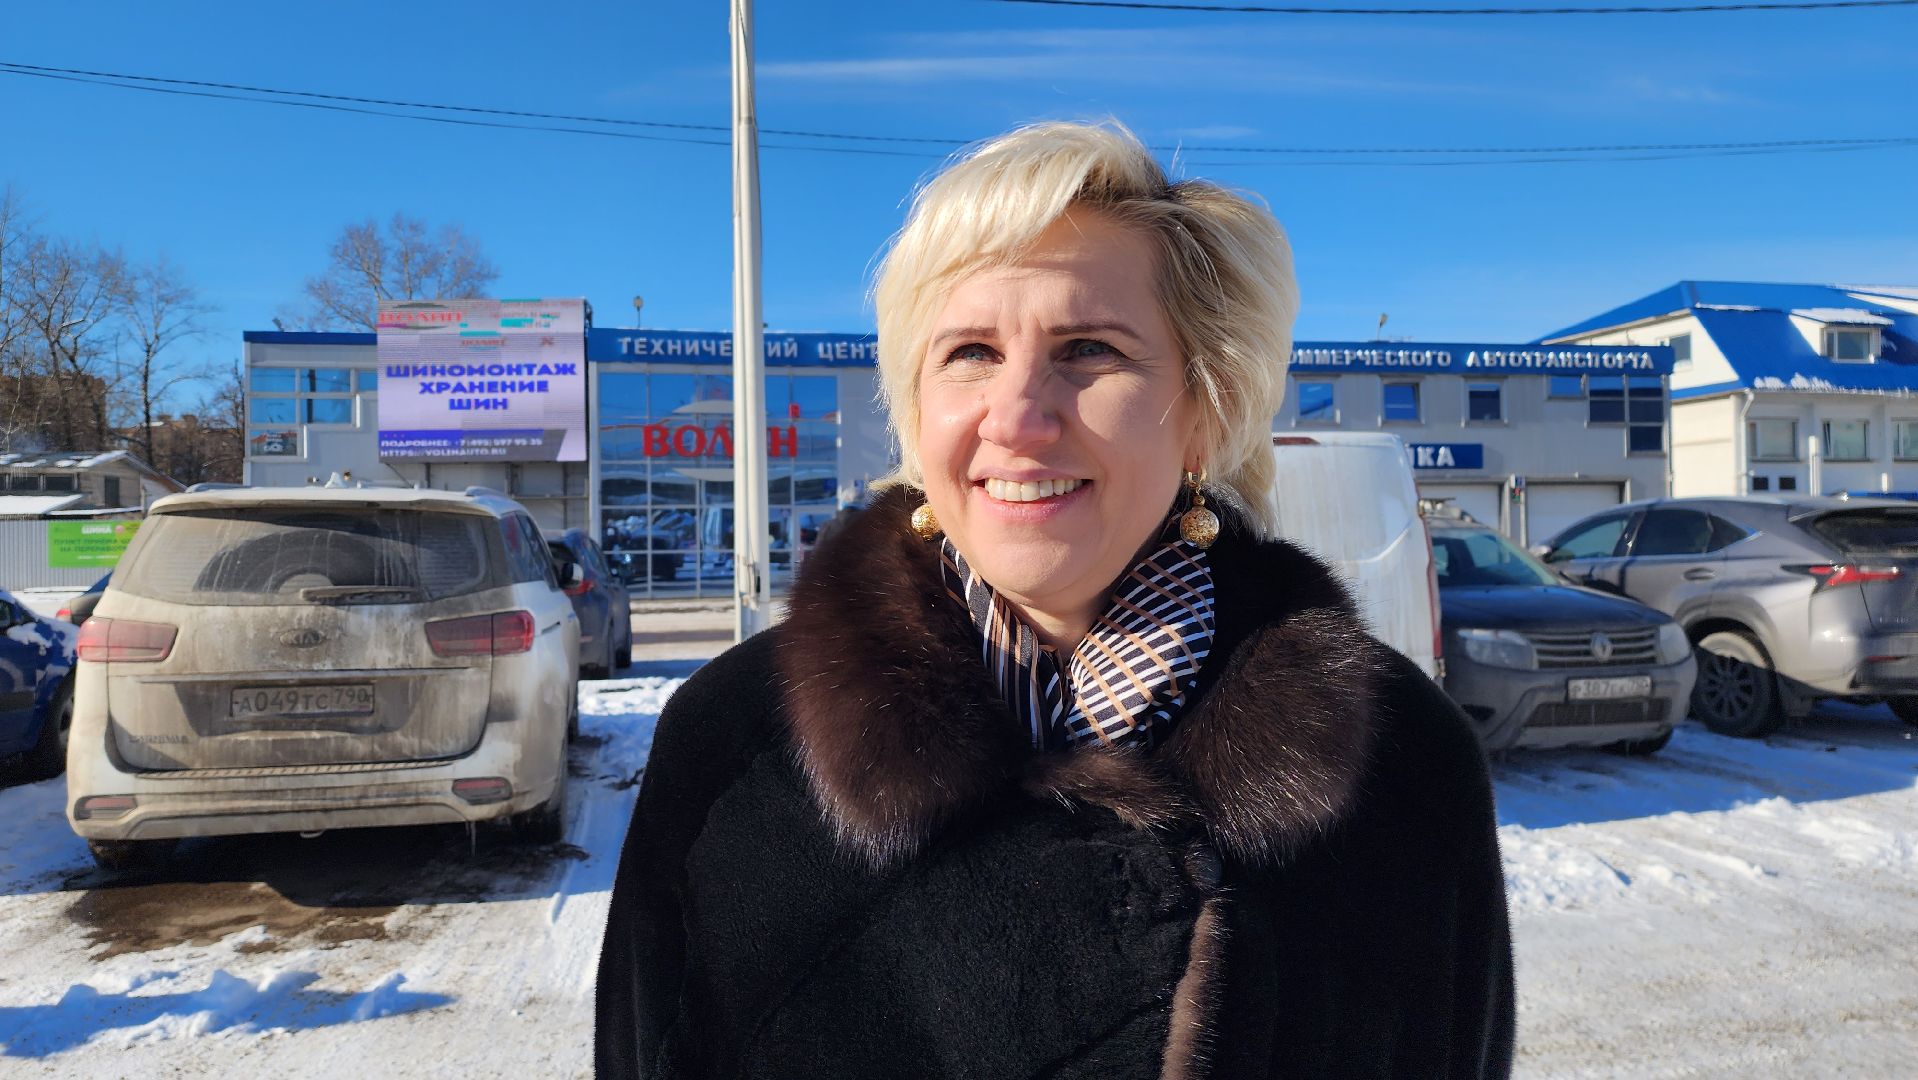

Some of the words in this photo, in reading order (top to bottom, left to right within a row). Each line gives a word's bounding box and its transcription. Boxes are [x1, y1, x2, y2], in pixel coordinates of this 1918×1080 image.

[618, 337, 798, 358] ТЕХНИЧЕИЙ
[1466, 350, 1654, 369] АВТОТРАНСПОРТА
[386, 363, 577, 378] ШИНОМОНТАЖ
[419, 380, 549, 394] ХРАНЕНИЕ
[449, 398, 509, 410] ШИН
[642, 424, 798, 458] ВОЛН
